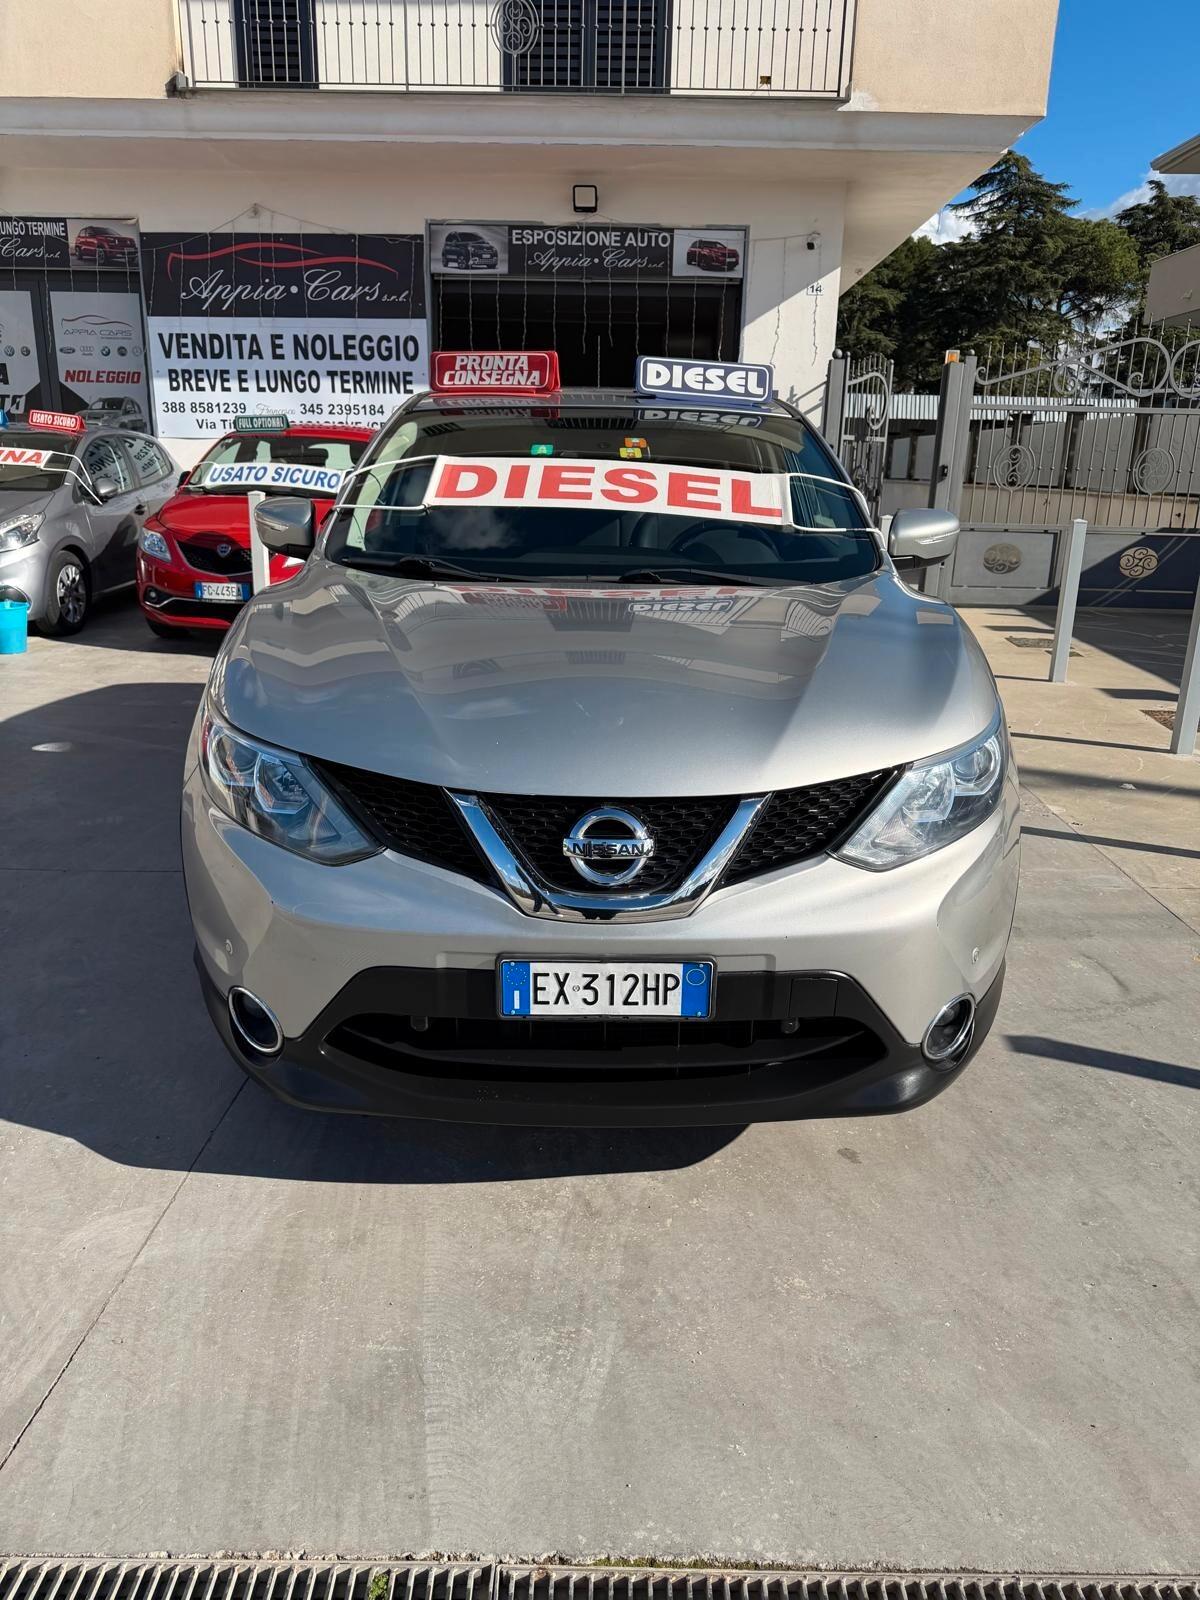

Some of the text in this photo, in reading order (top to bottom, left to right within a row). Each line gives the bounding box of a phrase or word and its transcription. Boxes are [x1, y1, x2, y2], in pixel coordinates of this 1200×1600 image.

[27, 221, 66, 236] TERMINE
[511, 229, 671, 248] ESPOSIZIONE AUTO
[809, 284, 823, 294] 14
[158, 332, 420, 362] VENDITA E NOLEGGIO
[454, 355, 529, 371] PRONTA
[64, 370, 141, 385] NOLEGGIO
[168, 368, 414, 395] BREVE E LUNGO TERMINE
[443, 369, 541, 387] CONSEGNA
[646, 363, 766, 395] DIESEL
[162, 401, 186, 414] 388
[190, 402, 247, 414] 8581239
[299, 403, 324, 416] 345
[328, 403, 385, 416] 2395184
[32, 412, 77, 427] USATO SICURO
[196, 418, 217, 430] Via
[237, 417, 252, 429] FULL
[253, 417, 284, 429] OPTIONAL
[209, 465, 341, 489] USATO SICURO
[434, 463, 783, 519] DIESEL
[572, 842, 645, 857] NISSAN
